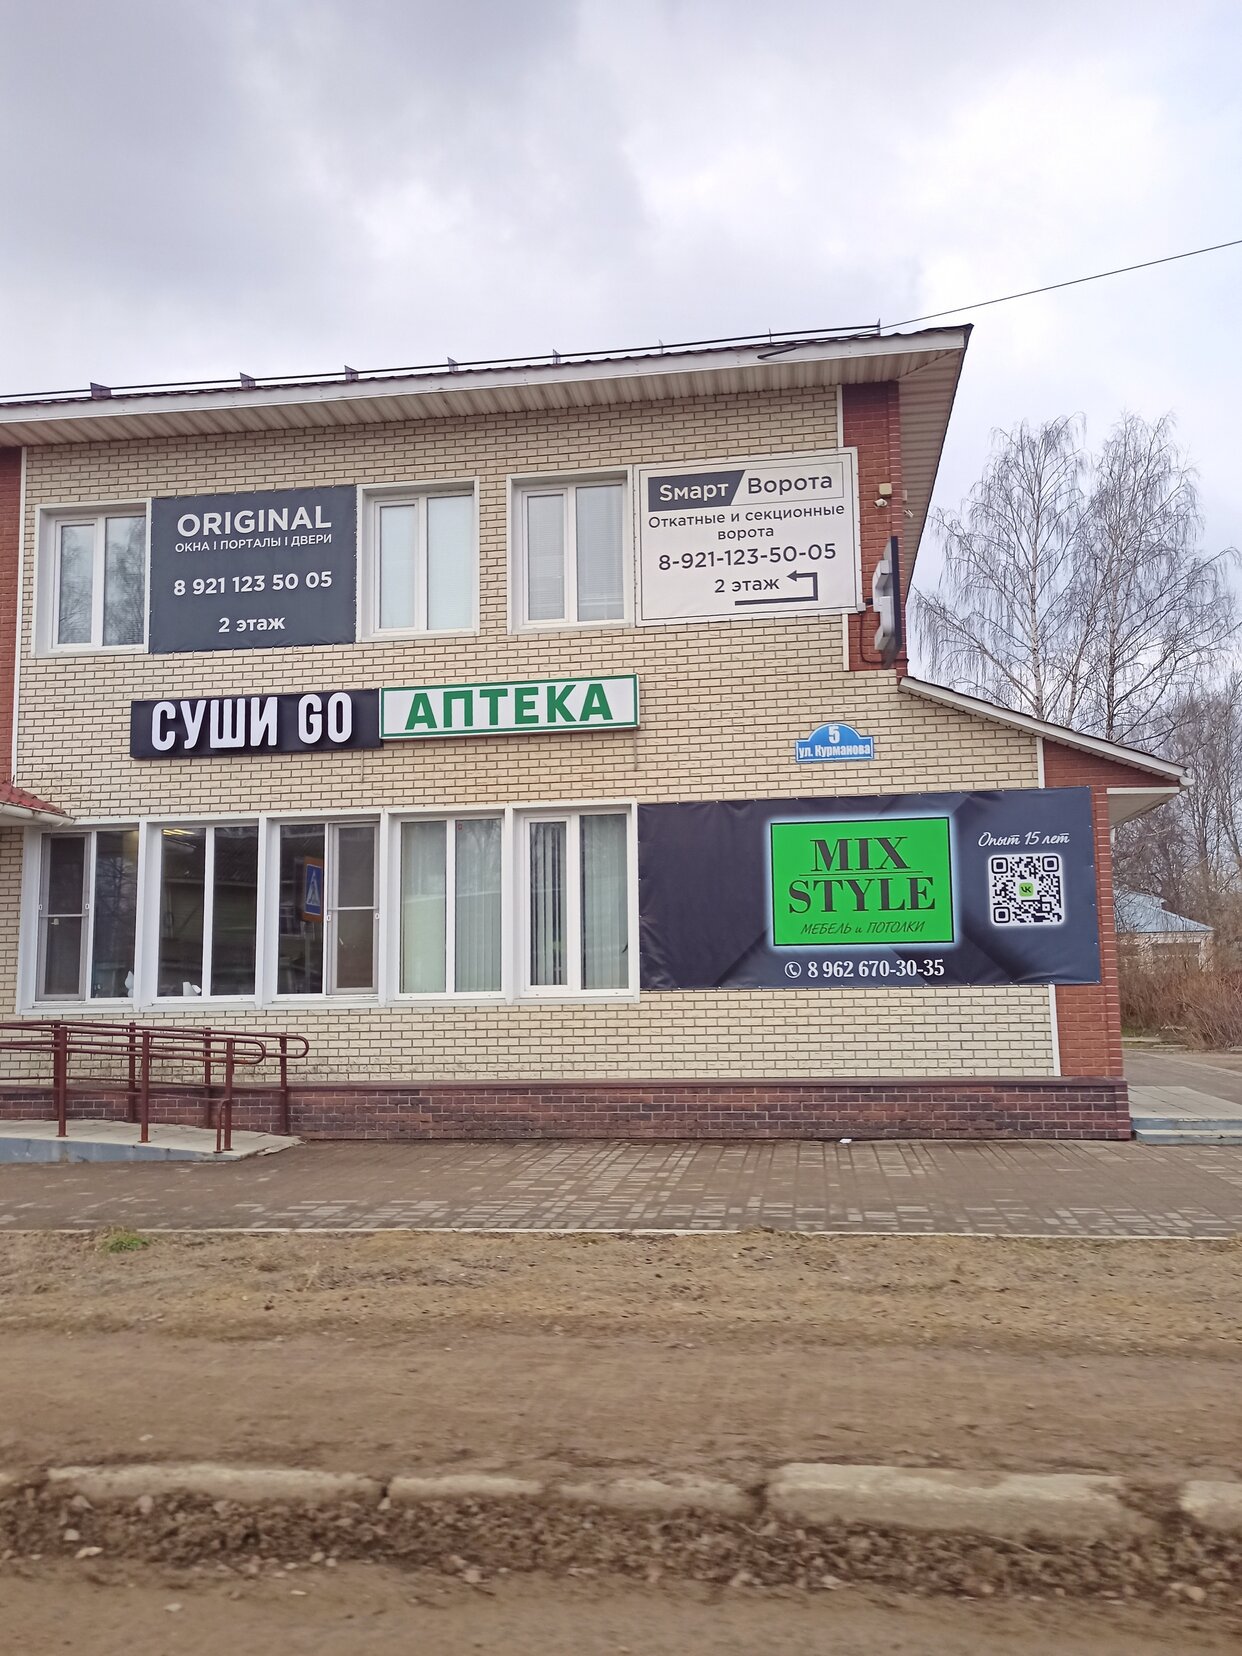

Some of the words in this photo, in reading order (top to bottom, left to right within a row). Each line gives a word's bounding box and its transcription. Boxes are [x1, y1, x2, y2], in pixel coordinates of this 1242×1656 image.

[747, 475, 833, 496] Ворота
[177, 505, 332, 537] ORIGINAL
[648, 512, 726, 528] Откатные
[730, 512, 740, 522] и
[745, 504, 845, 521] секционные
[175, 541, 210, 553] ОКНА
[220, 537, 281, 550] ПОРТАЛЫ
[291, 533, 332, 547] ДВЕРИ
[717, 527, 774, 541] ворота
[658, 543, 837, 571] 8-921-123-50-05
[173, 579, 186, 596] 8
[192, 577, 225, 595] 921
[232, 575, 265, 593] 123
[272, 573, 299, 591] 50
[305, 571, 333, 589] 05
[714, 579, 725, 593] 2
[731, 577, 780, 592] этаж
[218, 617, 230, 633] 2
[236, 616, 285, 632] этаж
[404, 682, 614, 731] АПТЕКА
[151, 697, 278, 751] СУШИ
[298, 692, 353, 745] GO
[828, 725, 840, 744] 5
[799, 747, 814, 758] ул.
[815, 744, 871, 758] Курманова
[978, 831, 1021, 847] Опыт
[1025, 831, 1041, 845] 15
[1041, 832, 1070, 845] лет
[810, 836, 911, 872] MIX
[788, 877, 936, 914] STYLE
[800, 922, 852, 935] МЕБЕЛЬ
[855, 926, 862, 934] и
[866, 920, 926, 934] ПОТОЛКИ
[807, 961, 819, 978] 8
[822, 960, 854, 978] 962
[858, 958, 945, 977] 670-30-35
